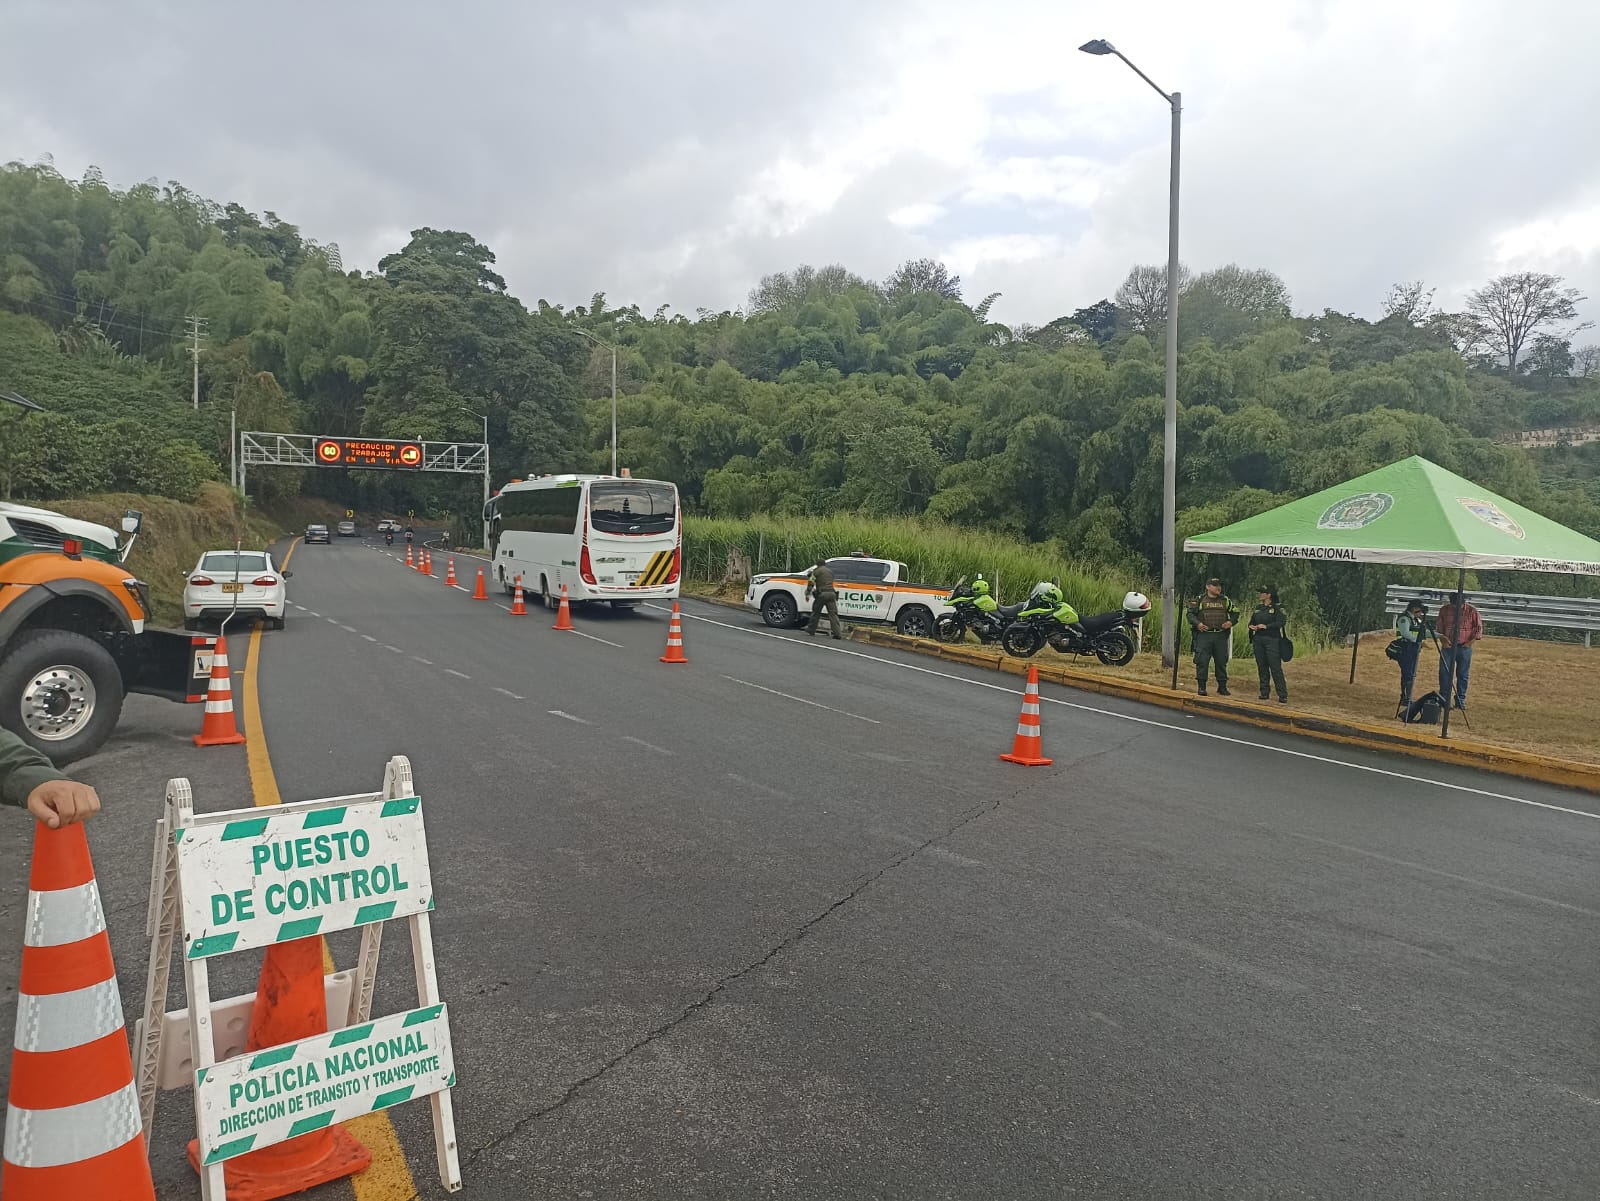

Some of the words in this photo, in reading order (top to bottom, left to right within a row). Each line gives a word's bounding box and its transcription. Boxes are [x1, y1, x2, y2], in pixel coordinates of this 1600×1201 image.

[324, 446, 336, 456] 60
[345, 442, 395, 451] PRECAUCION
[351, 449, 391, 457] TRABAJOS
[1260, 545, 1299, 556] POLICIA
[1301, 547, 1357, 560] NACIONAL
[836, 590, 875, 602] LICIA
[845, 602, 878, 611] TRANSPORTE
[253, 829, 370, 875] PUESTO
[211, 889, 255, 926] DE
[265, 863, 408, 915] CONTROL
[229, 1062, 320, 1107] POLICIA
[325, 1031, 428, 1079] NACIONAL
[219, 1104, 286, 1136] DIRECCION
[289, 1095, 304, 1114] DE
[306, 1080, 361, 1108] TRANSITO
[362, 1075, 370, 1091] Y
[372, 1055, 440, 1088] TRANSPORTE
